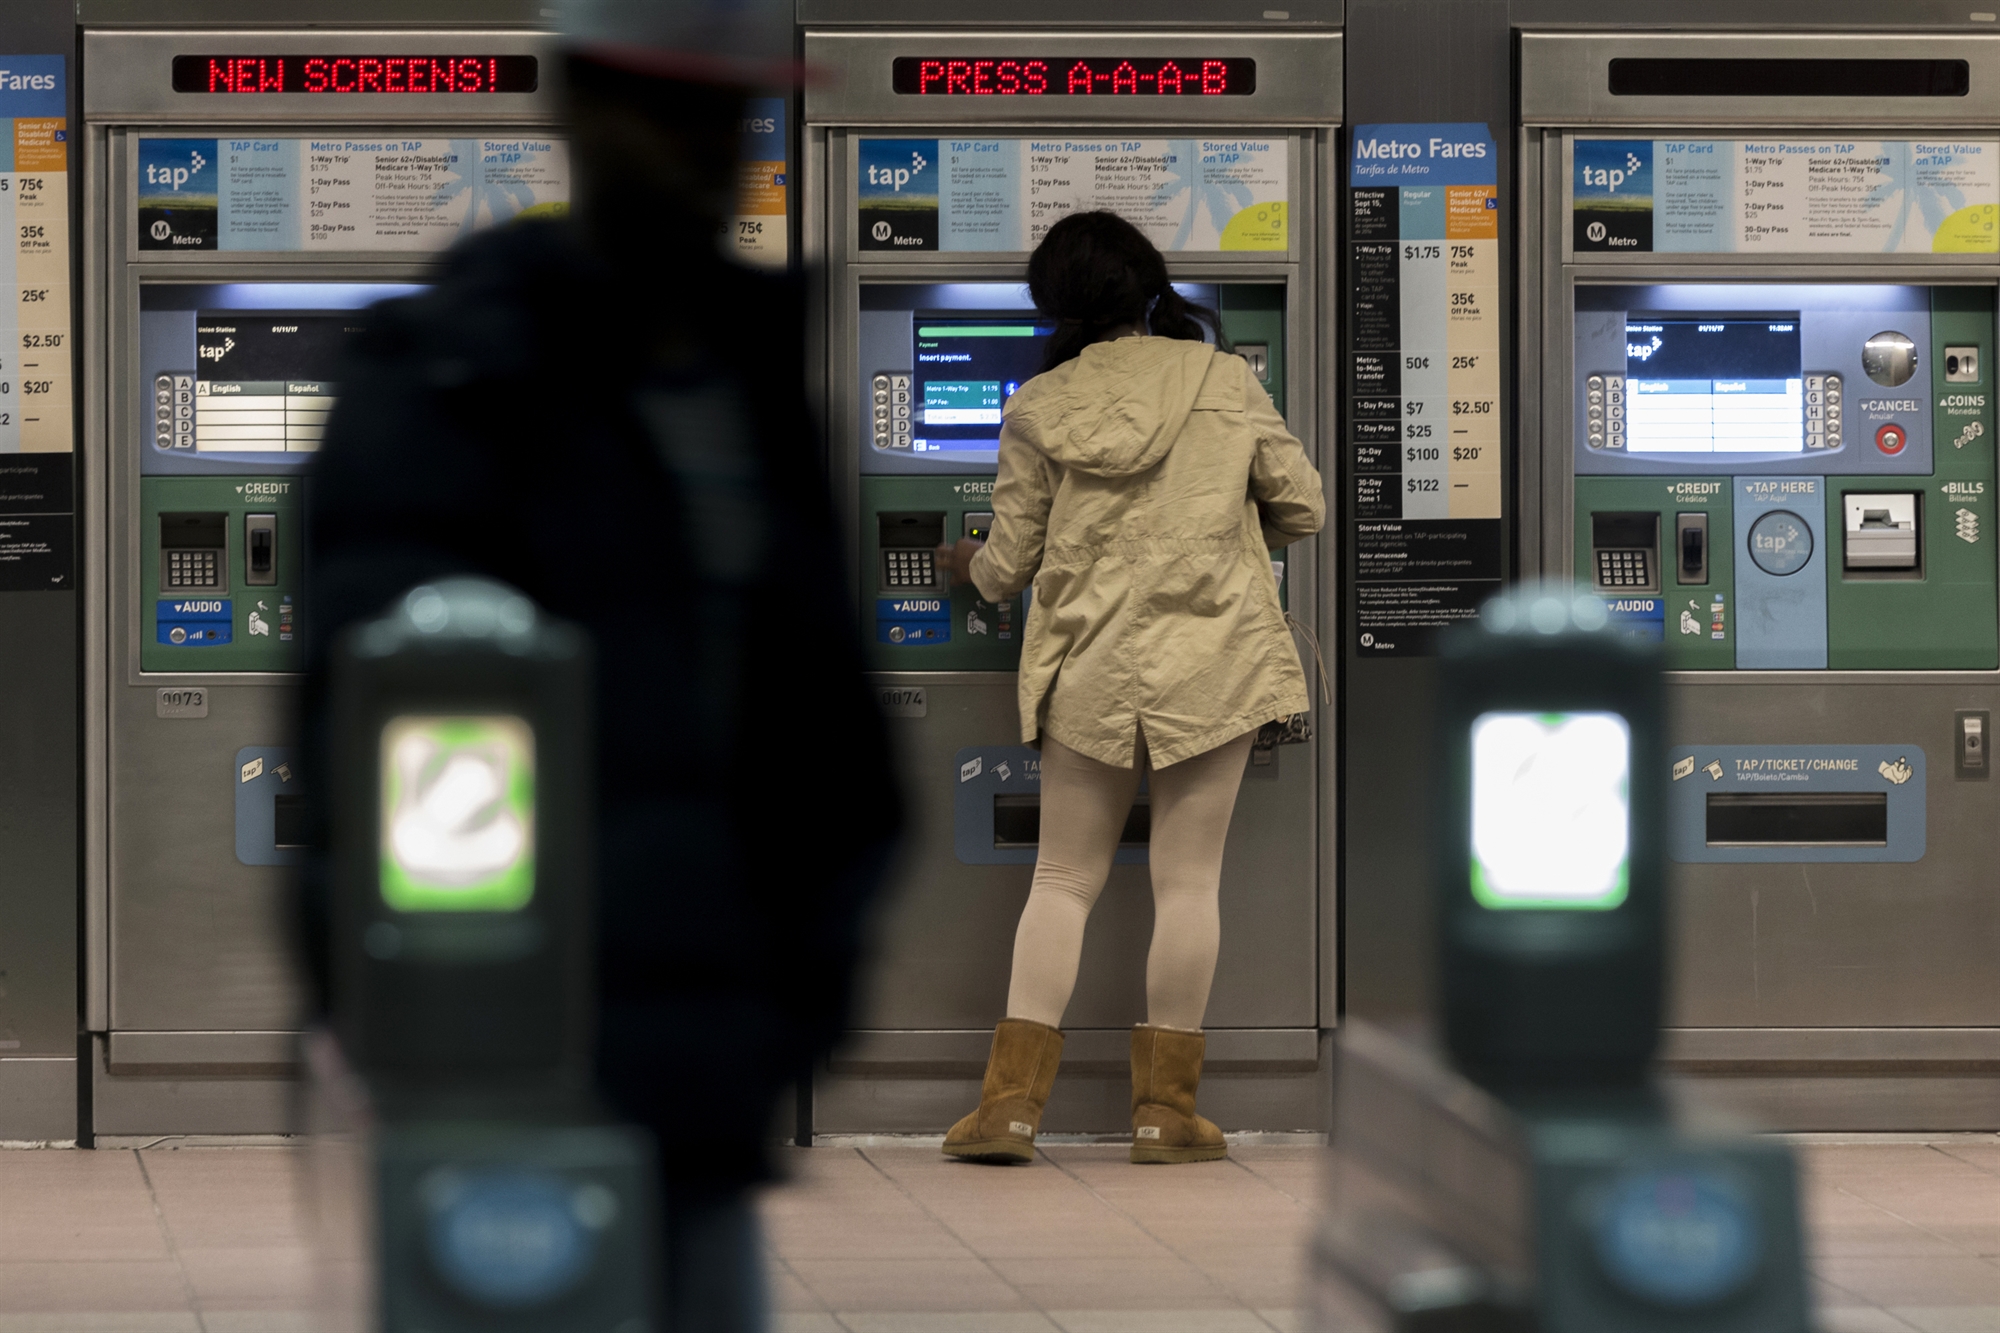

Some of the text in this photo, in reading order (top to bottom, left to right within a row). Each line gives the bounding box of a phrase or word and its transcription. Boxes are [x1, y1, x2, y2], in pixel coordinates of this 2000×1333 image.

[0, 71, 55, 90] Fares
[210, 59, 496, 92] NEW SCREENS!
[920, 61, 1227, 94] PRESS A-A-A-B
[230, 142, 278, 151] TAP Card
[311, 142, 342, 151] Metro
[347, 142, 382, 151] Passes
[402, 142, 421, 151] TAP
[484, 142, 551, 151] Stored Value
[951, 143, 998, 152] TAP Card
[1031, 143, 1061, 152] Metro
[1065, 143, 1102, 152] Passes
[1121, 143, 1141, 152] TAP
[1203, 142, 1269, 152] Stored Value
[1357, 139, 1486, 159] Metro Fares
[1665, 144, 1713, 153] TAP Card
[1745, 144, 1854, 154] Metro Passes on TAP
[1916, 145, 1982, 154] Stored Value
[1932, 157, 1951, 165] TAP
[1355, 165, 1429, 176] Tarifas de Metro
[1843, 166, 1864, 174] 1-Way
[147, 164, 188, 190] tap
[868, 165, 909, 191] tap
[1584, 166, 1624, 192] tap
[20, 179, 43, 191] 75¢
[1745, 203, 1767, 211] 7-Day
[21, 226, 44, 238] 35¢
[740, 222, 762, 233] 75¢
[1745, 226, 1772, 234] 30-Day
[173, 236, 202, 244] Metro
[894, 236, 922, 245] Metro
[1609, 237, 1637, 246] Metro
[1405, 246, 1440, 260] $1.75
[1451, 246, 1474, 258] 75¢
[1452, 293, 1475, 305] 35¢
[200, 344, 224, 361] tap
[1627, 343, 1652, 361] tap
[1406, 357, 1429, 369] 50¢
[198, 384, 207, 393] A
[289, 384, 318, 392] Español
[1869, 401, 1918, 411] CANCEL
[1948, 396, 1985, 406] COINS
[1407, 401, 1423, 416] $7
[1407, 424, 1431, 439] $25
[1358, 448, 1381, 456] 30-Day
[1407, 447, 1439, 462] $100
[245, 483, 290, 493] CREDIT
[1408, 479, 1439, 493] $122
[1677, 483, 1720, 493] CREDIT
[1754, 482, 1814, 493] TAP HERE
[1949, 483, 1984, 493] BILLS
[1756, 533, 1786, 552] tap
[183, 602, 221, 612] AUDIO
[902, 602, 940, 611] AUDIO
[1616, 601, 1654, 611] AUDIO
[162, 693, 203, 705] 0073
[1736, 759, 1858, 771] TAP/TICKET/CHANGE
[963, 766, 976, 778] tap
[1675, 766, 1687, 776] tap
[1736, 773, 1808, 781] TAP/Boleto/Cambio
